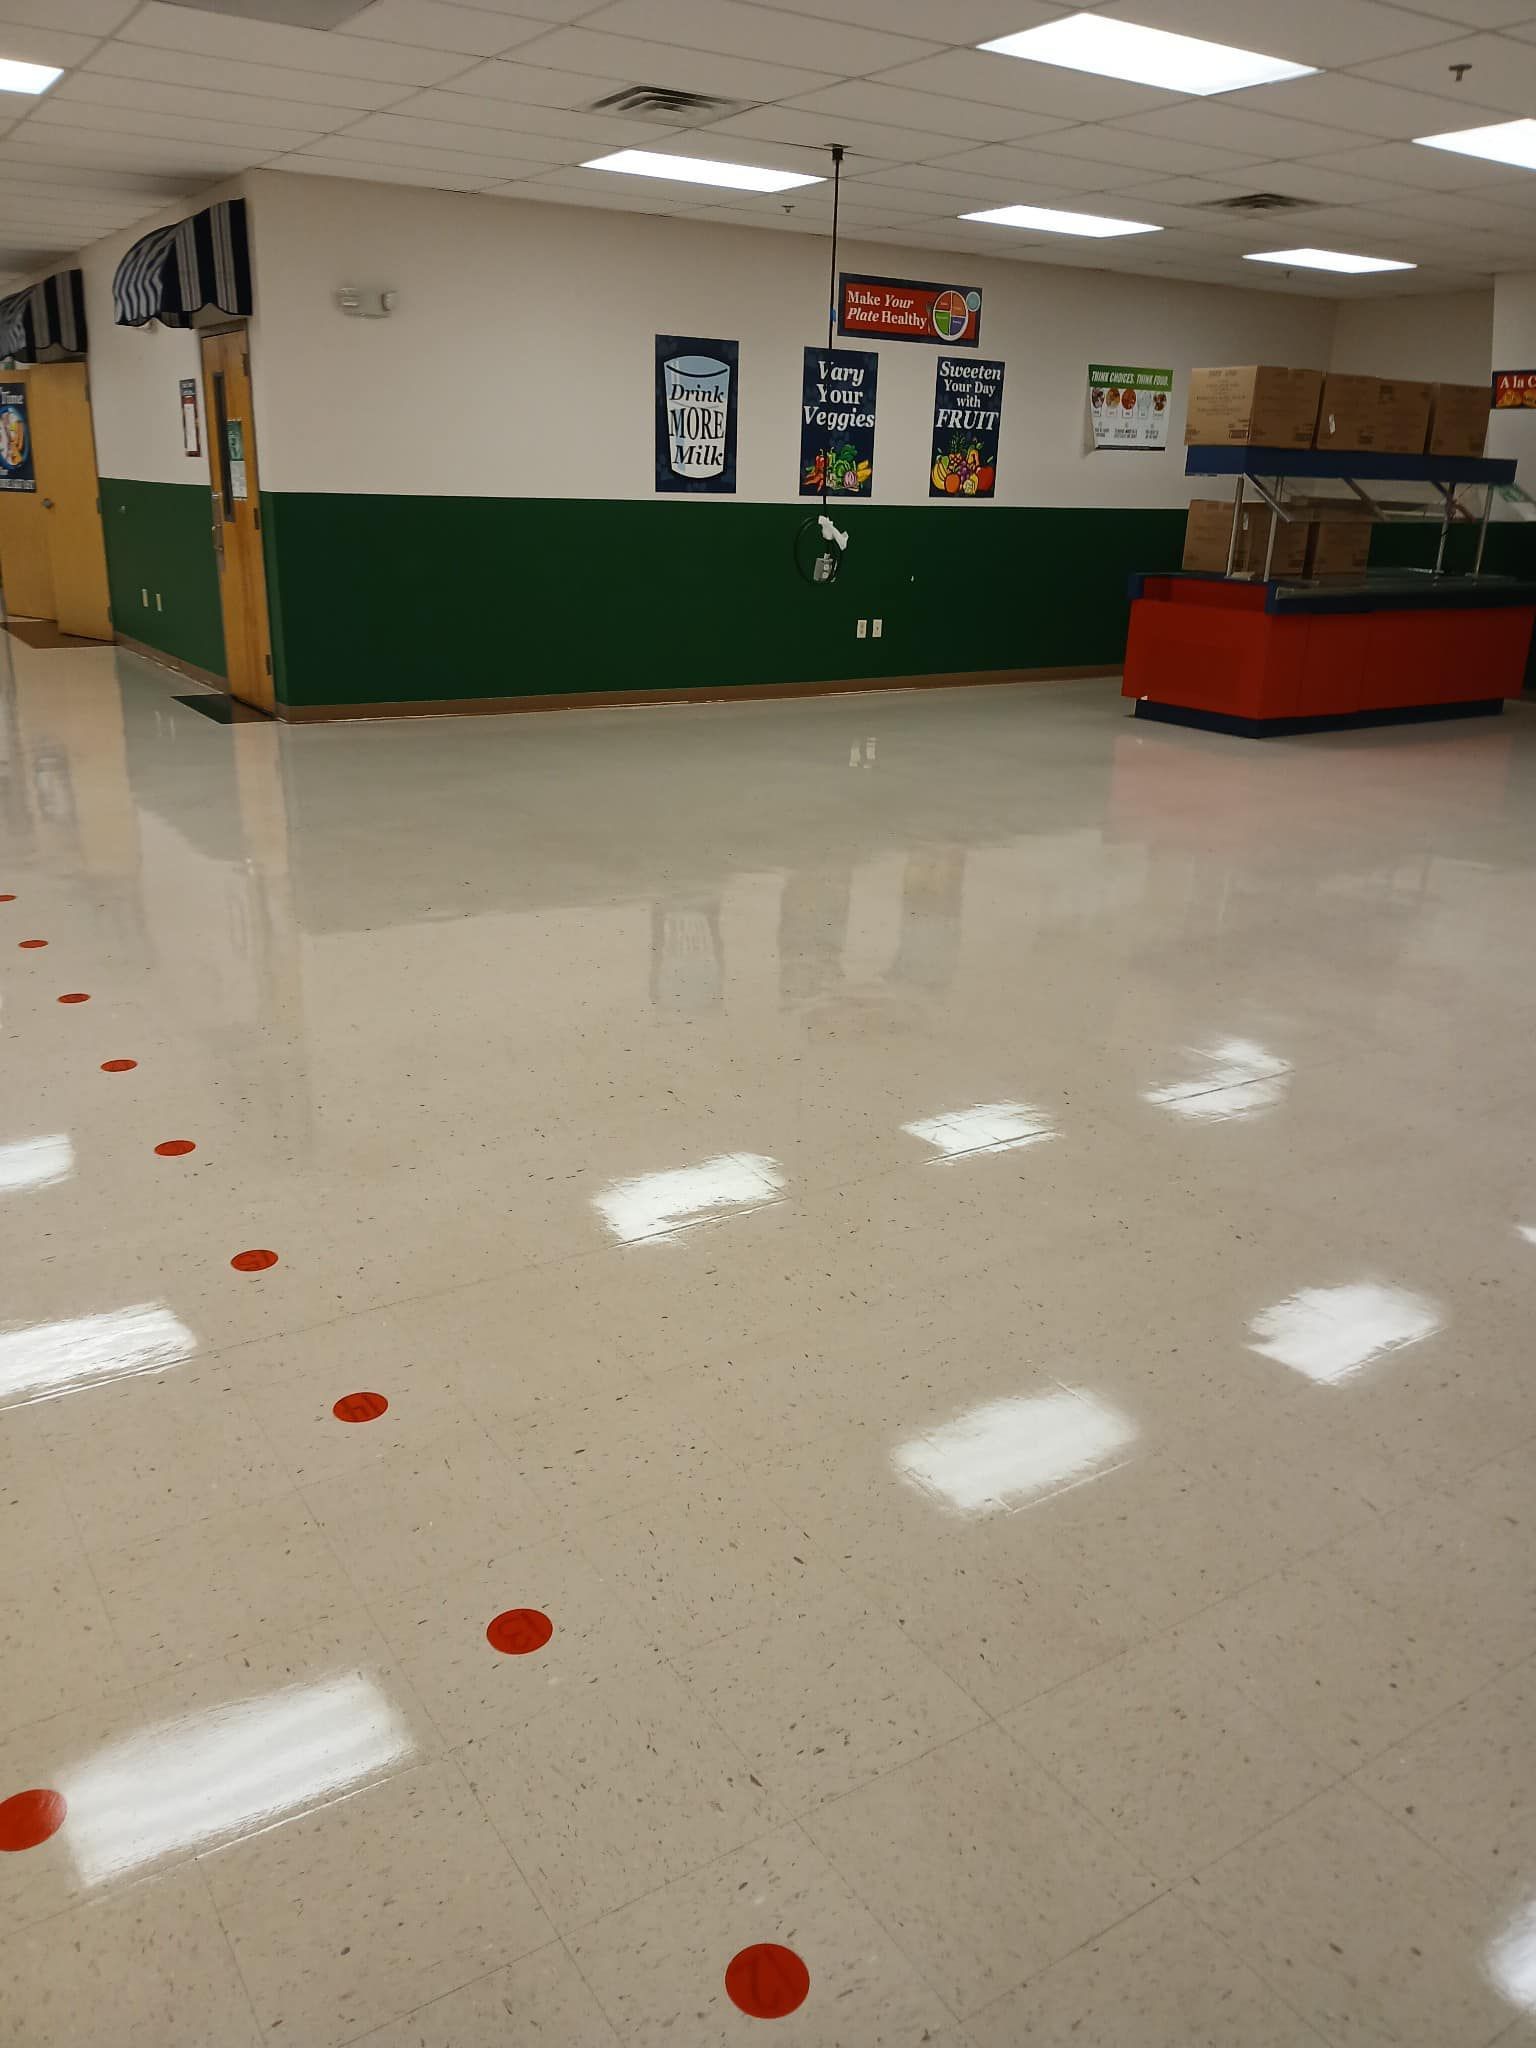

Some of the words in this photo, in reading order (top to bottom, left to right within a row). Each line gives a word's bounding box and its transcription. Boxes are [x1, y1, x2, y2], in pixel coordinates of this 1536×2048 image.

[847, 290, 880, 305] Make
[884, 294, 914, 309] Your
[846, 307, 880, 322] Plate
[881, 310, 928, 329] Healthy
[818, 360, 865, 387] Vary
[940, 360, 1001, 380] Sweeten
[944, 379, 972, 393] Your
[974, 381, 996, 397] Day
[1500, 375, 1509, 388] A
[669, 383, 724, 403] Drink
[816, 383, 864, 405] Your
[956, 394, 981, 408] with
[668, 406, 724, 440] MORE
[803, 405, 875, 431] Veggies
[935, 408, 1000, 431] FRUIT
[672, 444, 723, 466] Milk
